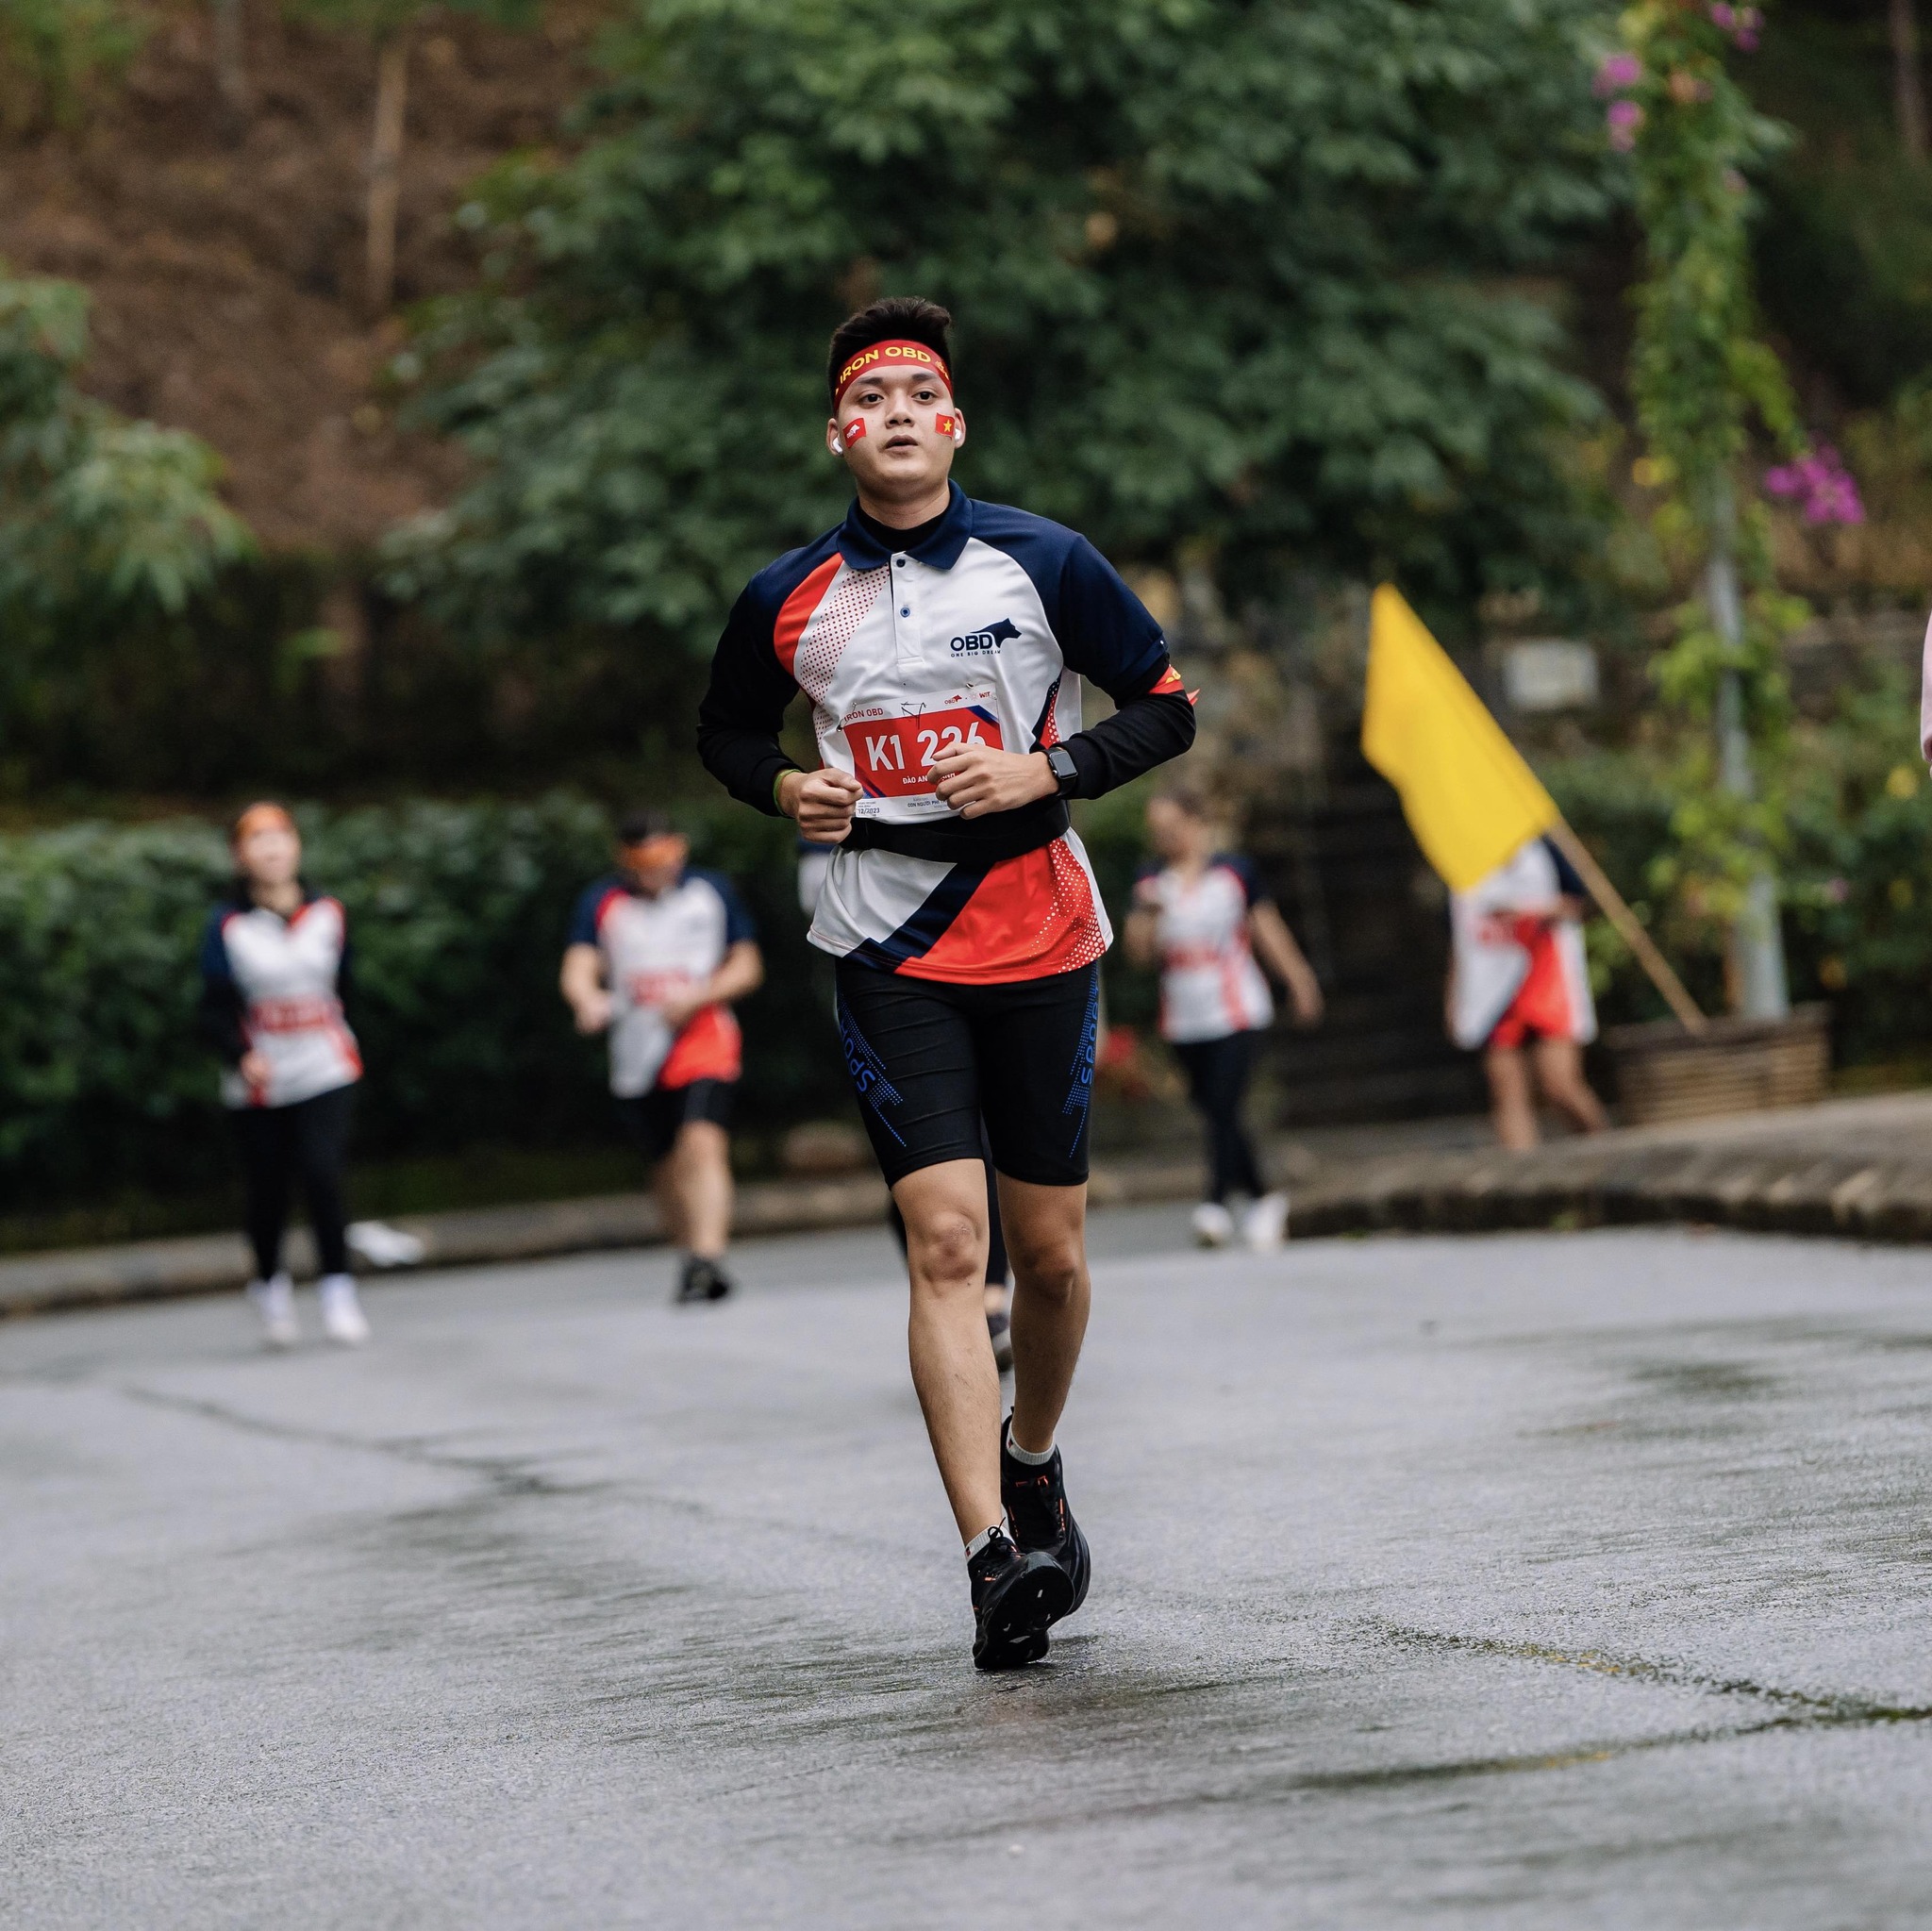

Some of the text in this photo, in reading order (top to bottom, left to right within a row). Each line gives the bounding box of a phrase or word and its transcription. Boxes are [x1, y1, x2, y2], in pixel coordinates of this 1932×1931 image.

[840, 346, 931, 384] IRON OBD
[950, 634, 993, 652] OBD
[843, 707, 884, 722] IRON OBD
[865, 734, 906, 772] K1
